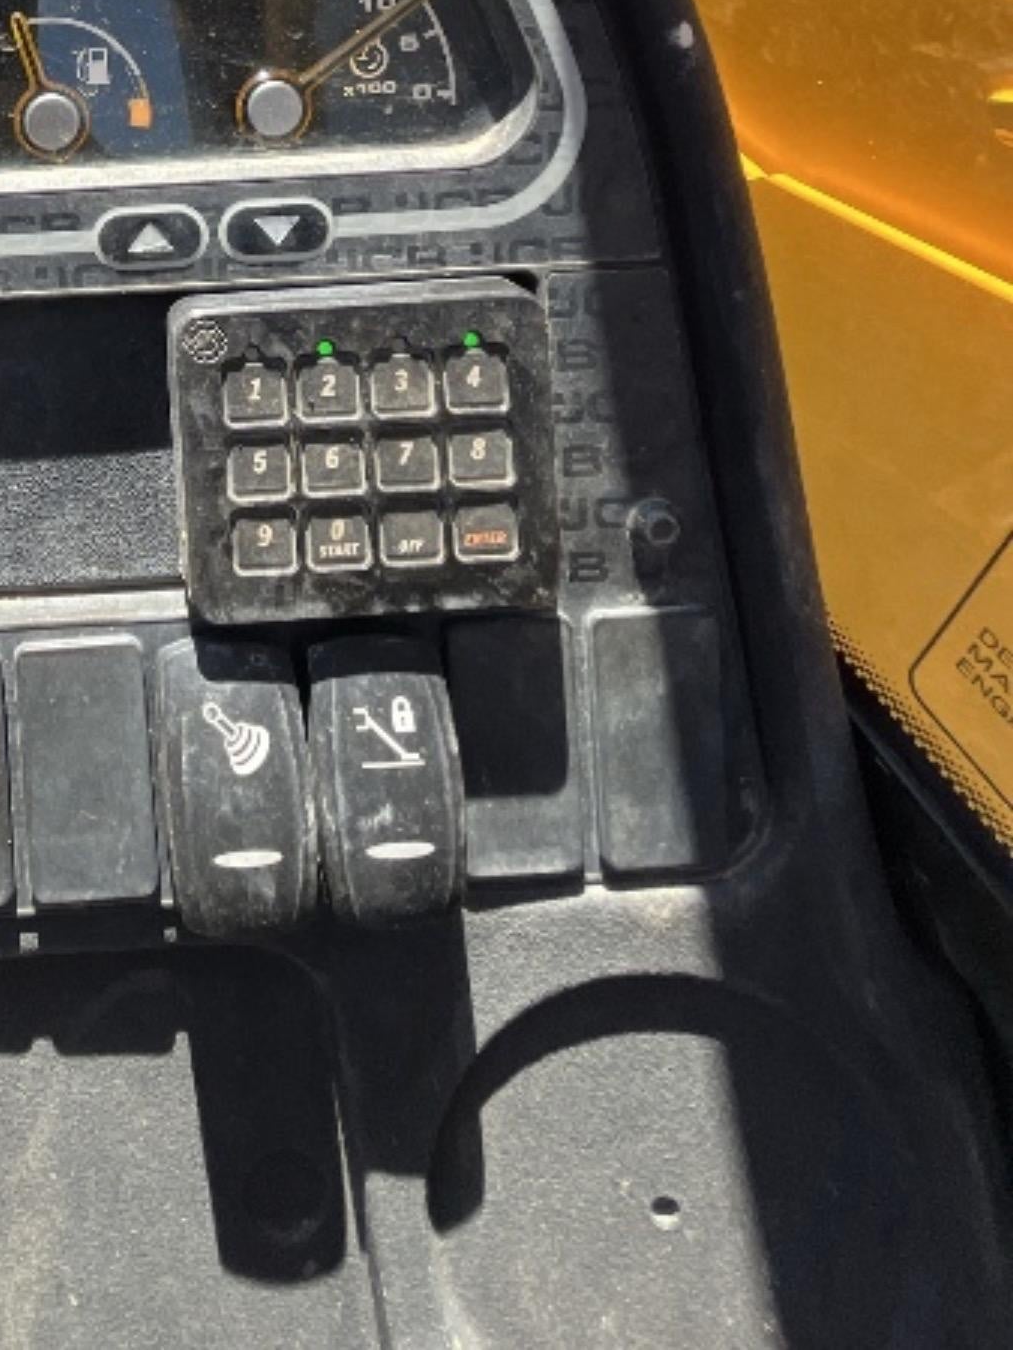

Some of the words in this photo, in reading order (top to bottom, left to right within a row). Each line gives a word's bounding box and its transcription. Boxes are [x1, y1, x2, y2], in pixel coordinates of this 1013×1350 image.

[400, 34, 420, 52] 5
[413, 83, 432, 100] 0
[248, 379, 262, 401] 1
[321, 375, 336, 397] 2
[394, 370, 409, 392] 3
[466, 365, 482, 388] 4
[253, 452, 267, 473] 5
[326, 448, 340, 469] 6
[399, 443, 414, 465] 7
[470, 439, 486, 461] 8
[257, 525, 272, 547] 9
[330, 519, 346, 540] 0
[319, 542, 360, 559] START
[956, 656, 1013, 725] ENG
